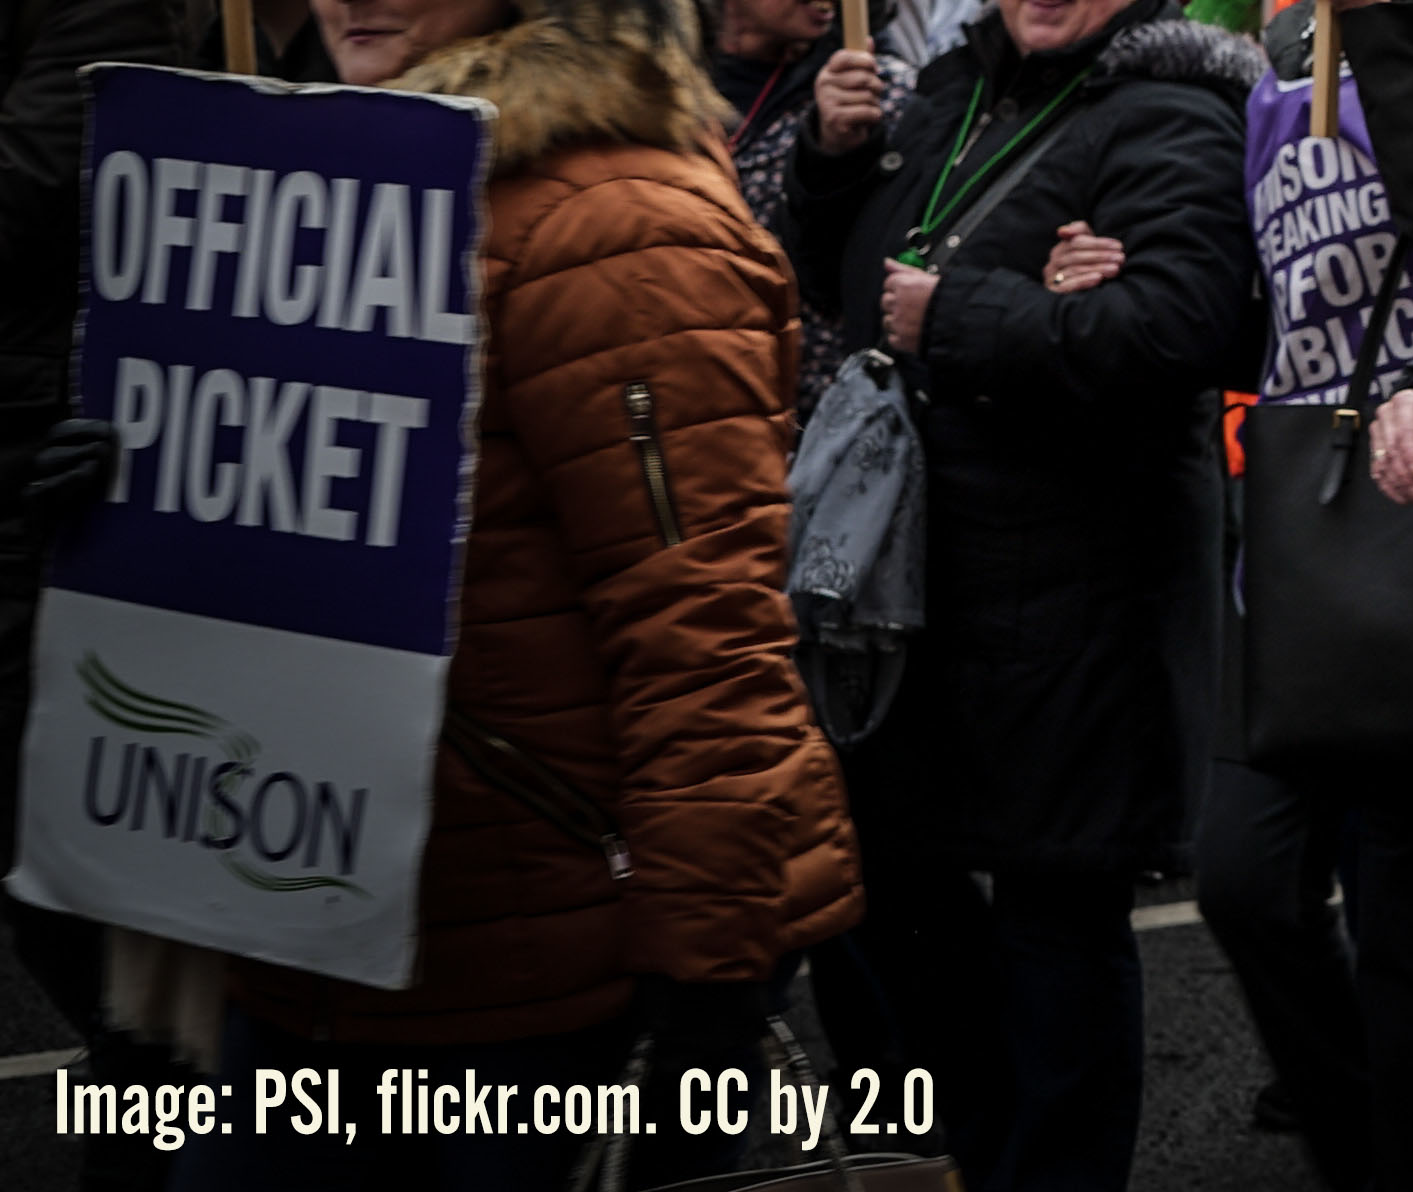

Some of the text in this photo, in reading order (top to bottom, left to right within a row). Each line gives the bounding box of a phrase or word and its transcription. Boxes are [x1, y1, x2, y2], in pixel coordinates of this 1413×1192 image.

[92, 148, 477, 346] OFFICIAL
[104, 354, 430, 552] PICKET
[85, 734, 369, 877] UNISON
